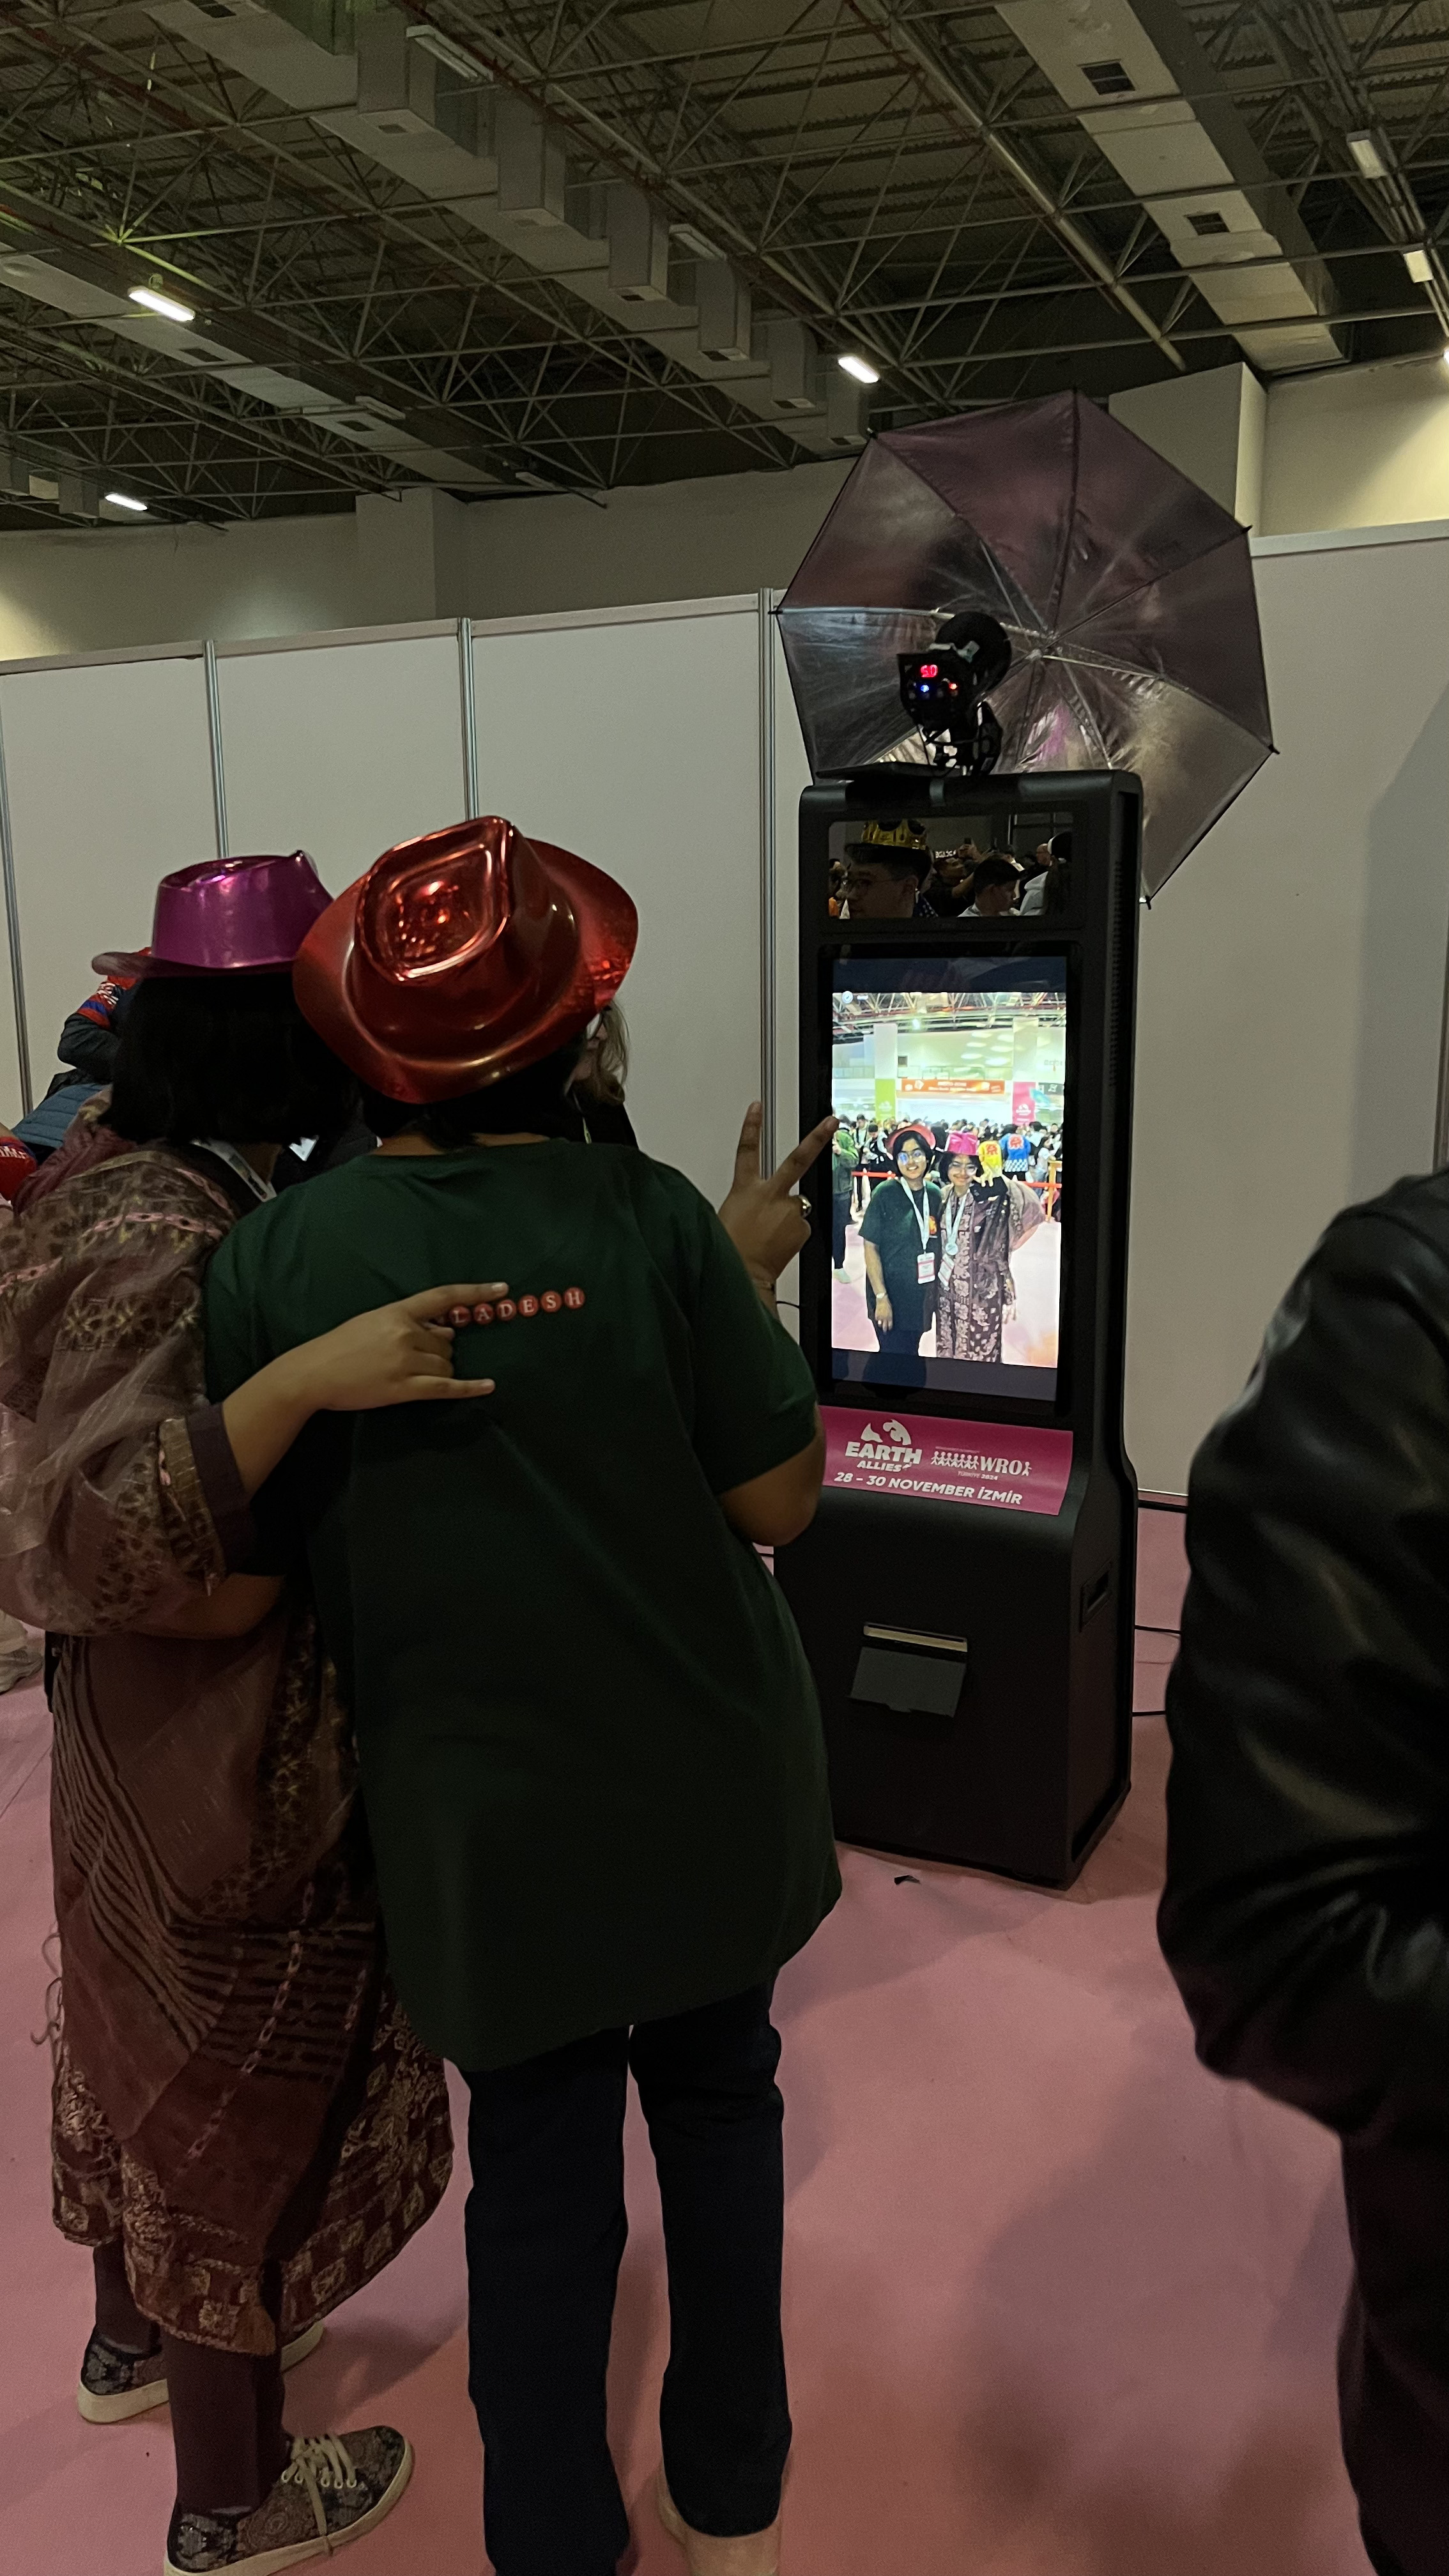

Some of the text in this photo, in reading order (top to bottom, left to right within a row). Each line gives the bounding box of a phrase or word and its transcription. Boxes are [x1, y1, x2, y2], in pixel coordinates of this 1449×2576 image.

[441, 1290, 582, 1325] LADESH
[845, 1441, 923, 1464] EARTH
[857, 1460, 901, 1472] ALLIES
[980, 1456, 1023, 1475] WRO
[834, 1472, 854, 1482] 28
[866, 1475, 886, 1486] 30
[888, 1478, 975, 1498] NOVEMBER
[977, 1487, 1023, 1505] İZMİR
